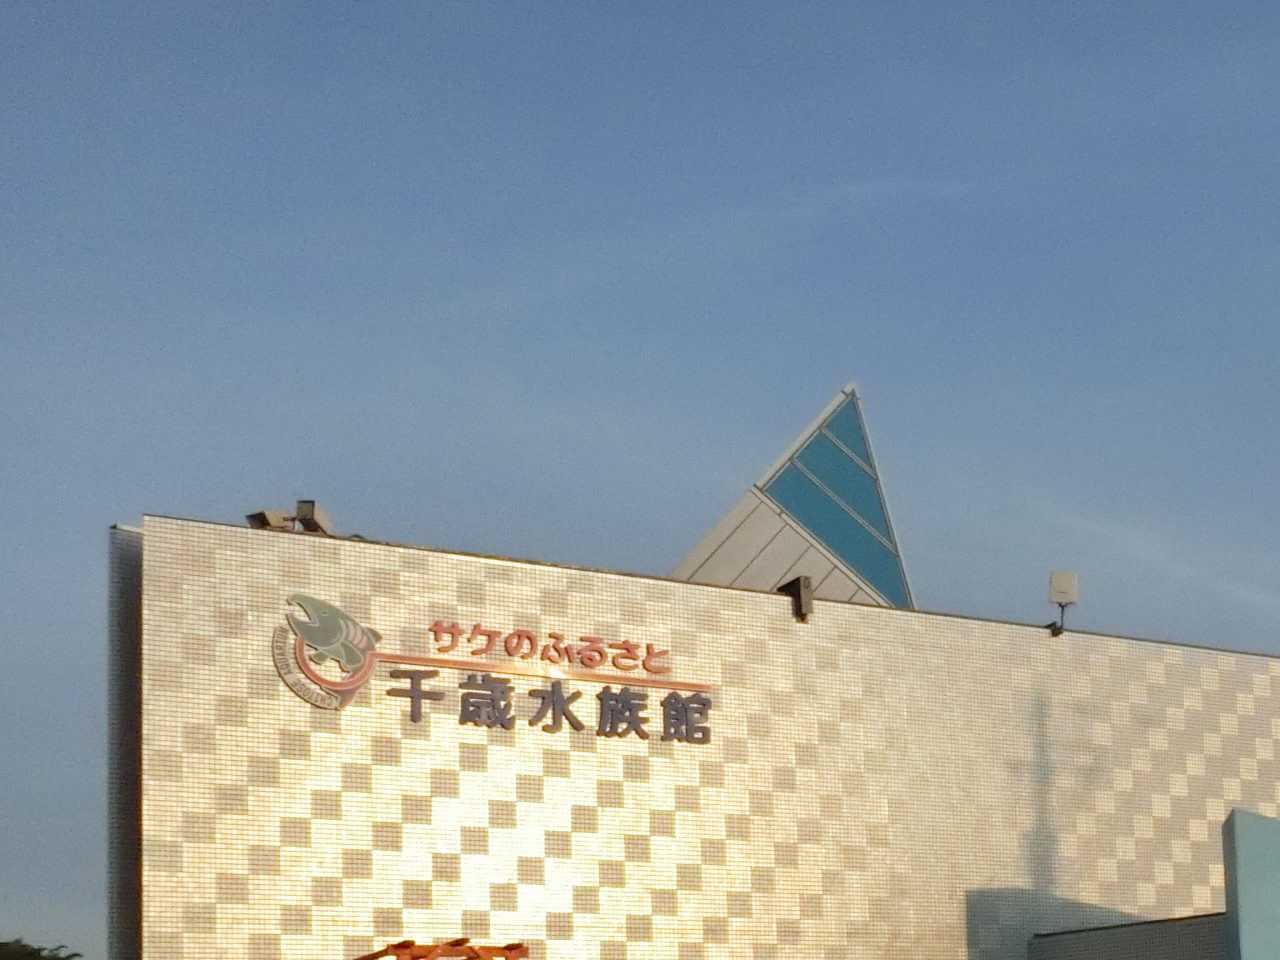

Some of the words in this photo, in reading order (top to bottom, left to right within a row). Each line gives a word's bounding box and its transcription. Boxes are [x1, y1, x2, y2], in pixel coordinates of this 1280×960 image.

[430, 620, 672, 674] サケのふるさと
[386, 668, 712, 745] 千歳水族館
